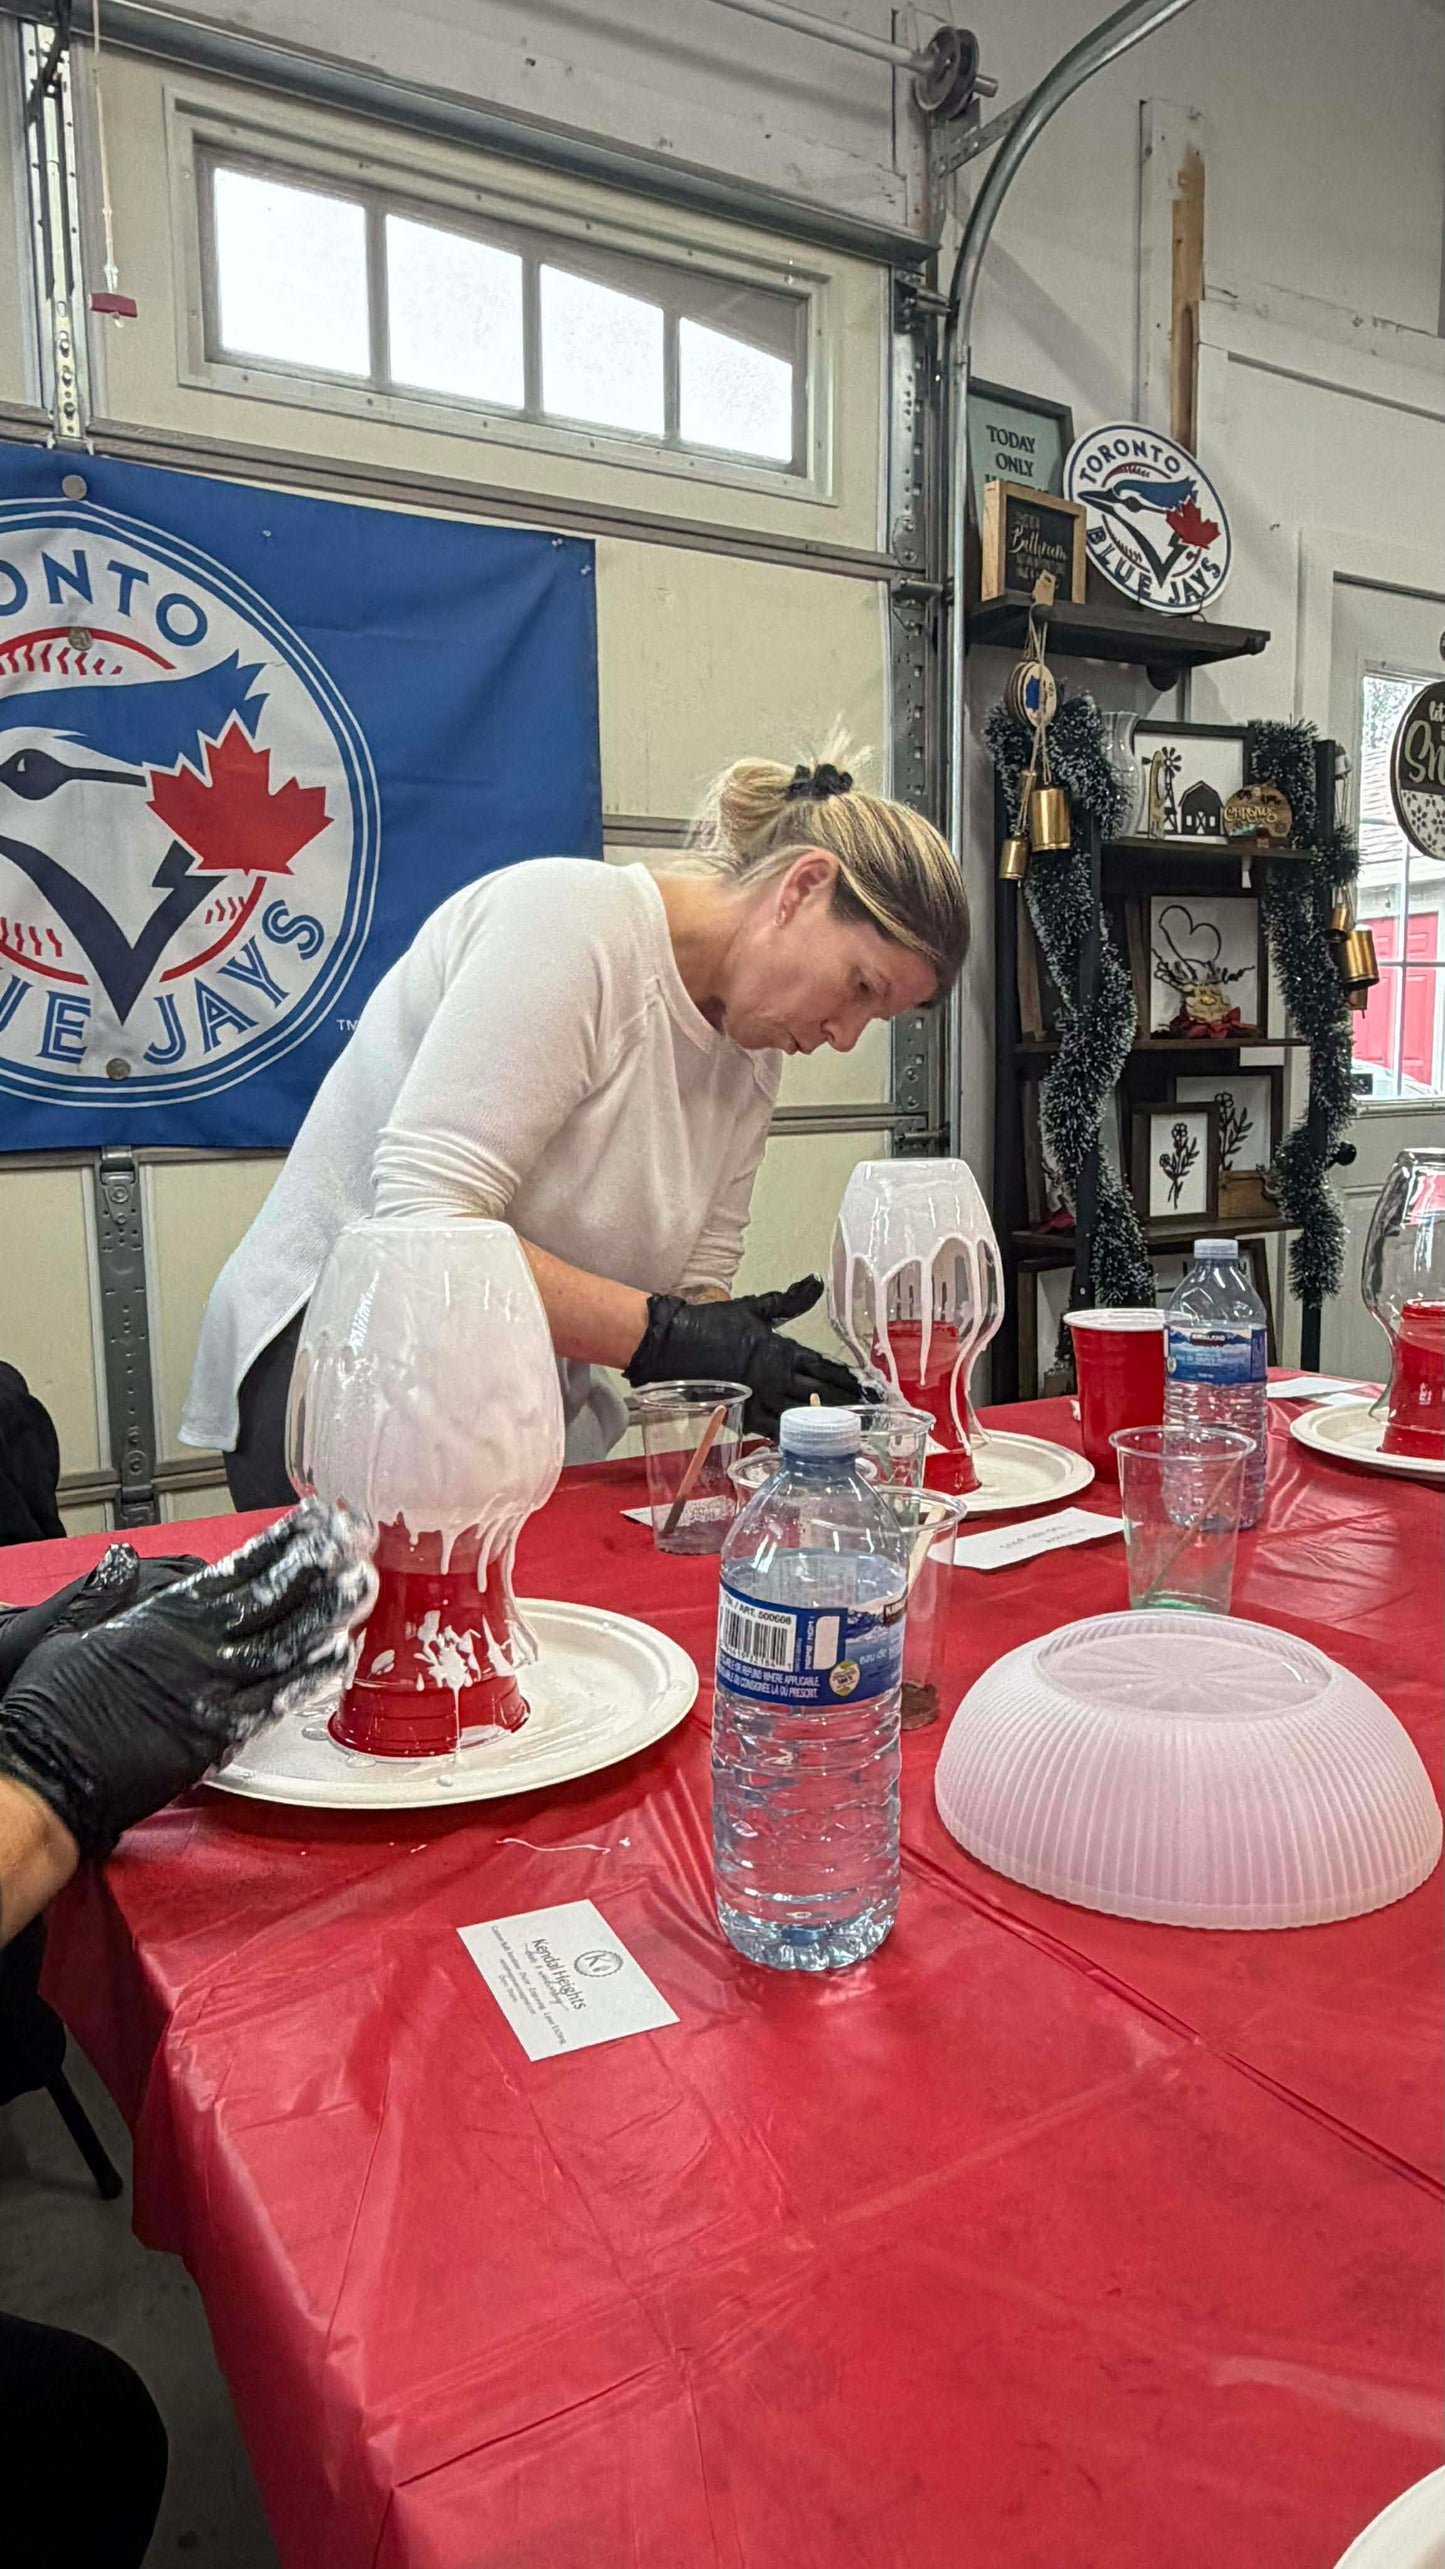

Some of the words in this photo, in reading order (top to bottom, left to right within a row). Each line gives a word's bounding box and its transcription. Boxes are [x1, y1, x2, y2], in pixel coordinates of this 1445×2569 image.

[986, 425, 1035, 453] TODAY
[1080, 439, 1180, 484] TORONTO
[996, 453, 1033, 477] ONLY
[1087, 526, 1152, 599] BLUE
[1169, 557, 1221, 604] JAYS
[143, 899, 324, 1065] JAYS
[763, 1671, 784, 1684] WHERE
[531, 1938, 564, 1970] Kendal
[552, 1969, 586, 2010] Heights
